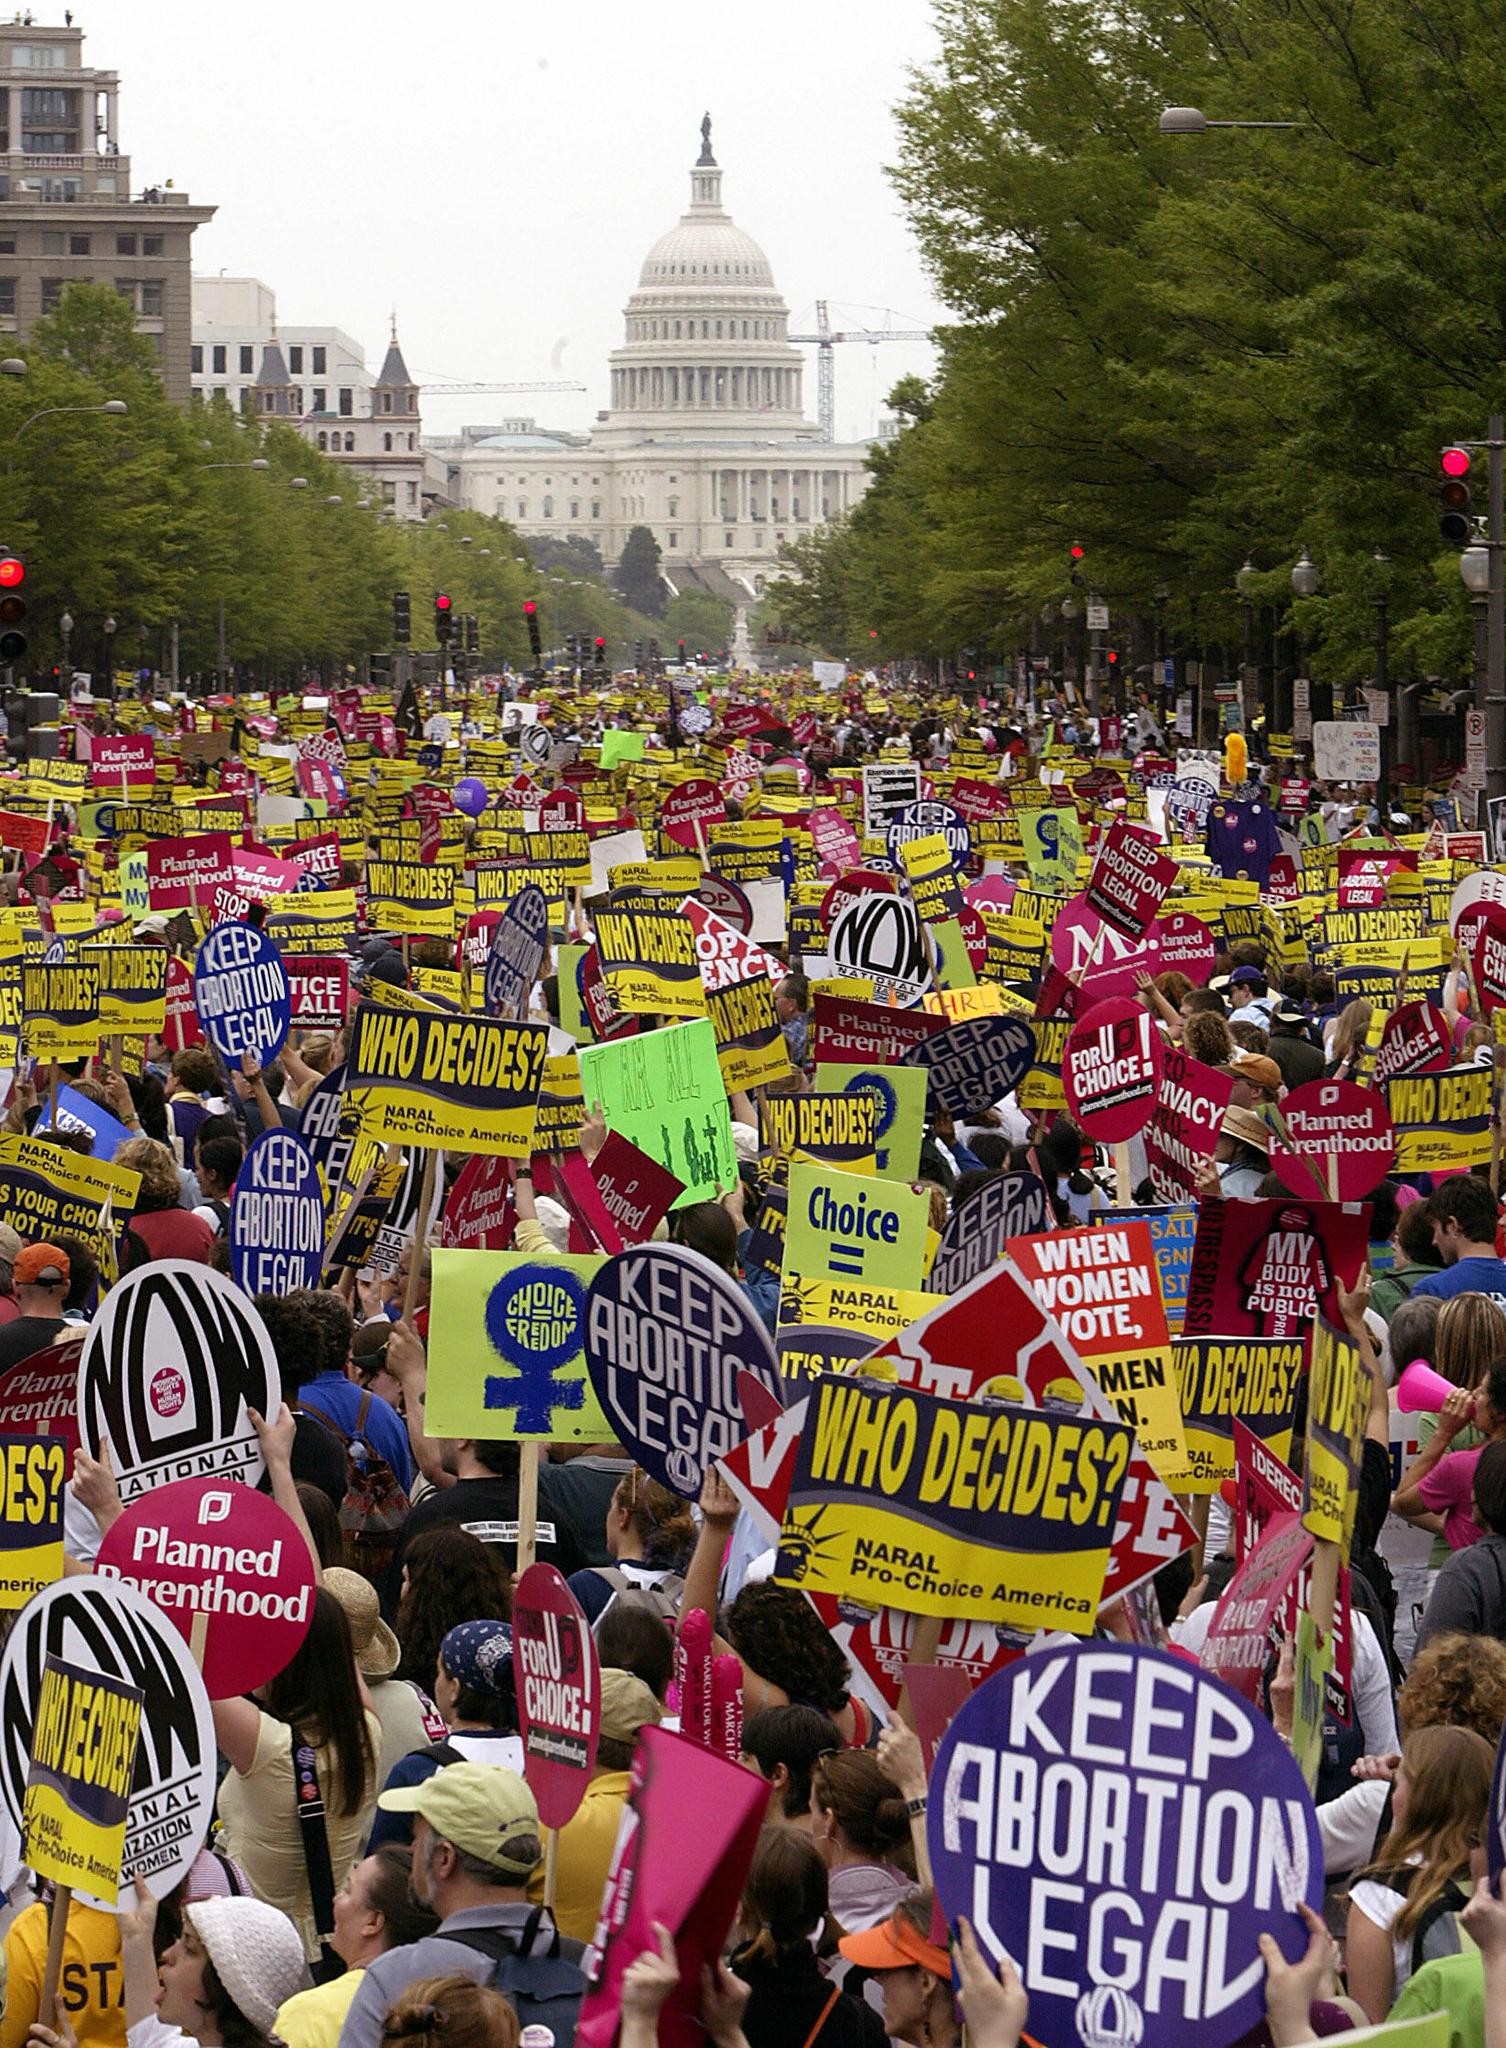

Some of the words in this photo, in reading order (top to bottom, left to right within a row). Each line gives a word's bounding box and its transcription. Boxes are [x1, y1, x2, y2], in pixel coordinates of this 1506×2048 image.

[93, 758, 154, 772] Parenthood
[101, 748, 144, 761] Planned
[28, 758, 48, 777] WHO
[48, 762, 88, 782] DECIDES?
[662, 803, 725, 826] Parenthood
[670, 794, 715, 809] Planned
[904, 802, 956, 826] KEEP
[114, 809, 138, 830] WHO
[141, 812, 183, 836] DECIDES?
[161, 852, 218, 870] Planned
[746, 852, 780, 864] CHOICE
[1120, 834, 1158, 867] KEEP
[150, 866, 233, 889] Parenthood
[369, 865, 399, 898] WHO
[396, 866, 454, 900] DECIDES?
[478, 871, 504, 899] WHO
[1102, 849, 1167, 901] ABORTION
[214, 887, 249, 917] STOP
[627, 898, 655, 910] YOUR
[1102, 876, 1139, 911] LEGAL
[1347, 890, 1373, 903] LEGAL
[269, 925, 286, 938] IT'S
[290, 924, 316, 937] YOUR
[318, 921, 355, 935] CHOICE
[419, 919, 452, 927] America
[986, 916, 1010, 926] NARAL
[1325, 914, 1356, 943] WHO
[1359, 910, 1422, 941] DECIDES?
[204, 926, 261, 973] KEEP
[312, 938, 348, 949] THEIRS.
[596, 914, 635, 961] WHO
[635, 914, 698, 967] DECIDES?
[696, 931, 737, 960] OP
[832, 899, 931, 982] NOW
[1159, 943, 1215, 961] renthood
[1161, 930, 1202, 946] lanned
[700, 953, 785, 991] ENCE
[1006, 951, 1042, 967] CHOICE
[25, 969, 48, 1010] WHO
[196, 960, 286, 1018] ABORTION
[288, 977, 341, 995] TICE
[432, 974, 454, 985] NARAL
[630, 984, 657, 992] NARAL
[1338, 980, 1360, 994] IT'S
[1361, 978, 1393, 992] YOUR
[298, 996, 341, 1013] ALL
[386, 988, 414, 1009] NARAL
[632, 994, 673, 1004] Pro-Choice
[675, 998, 704, 1007] America
[210, 1007, 283, 1057] LEGAL
[818, 1026, 911, 1057] Parenth
[838, 1012, 929, 1041] Planned
[357, 1012, 420, 1080] WHO
[422, 1024, 546, 1092] DECIDES?
[905, 1020, 993, 1067] KEEP
[930, 1026, 1028, 1089] ORTION
[759, 1058, 788, 1073] America
[1070, 1048, 1101, 1074] FOR
[936, 1061, 1024, 1111] EGAL
[1389, 1077, 1436, 1124] WHO
[384, 1104, 436, 1122] NARAL
[800, 1096, 875, 1146] DECIDES?
[1286, 1108, 1373, 1132] Planned
[383, 1118, 465, 1140] Pro-Choice
[468, 1128, 528, 1146] America
[20, 1142, 66, 1167] NARAL
[252, 1134, 311, 1190] KEEP
[17, 1154, 81, 1181] Pro-Choice
[84, 1178, 133, 1198] America
[15, 1190, 59, 1219] YOUR
[469, 1184, 502, 1211] Planned
[596, 1177, 652, 1231] Planned
[3, 1211, 37, 1235] NOT
[234, 1197, 321, 1253] ABORTION
[350, 1215, 378, 1239] IT'S
[458, 1205, 505, 1239] Parenthood
[808, 1186, 899, 1245] Choice
[1032, 1230, 1131, 1273] WHEN
[1266, 1232, 1315, 1265] MY
[1029, 1264, 1152, 1310] WOMEN
[1262, 1264, 1311, 1285] BODY
[506, 1282, 577, 1319] CHOICE
[618, 1258, 744, 1347] KEEP
[830, 1288, 899, 1312] NARAL
[1253, 1280, 1275, 1295] is
[1278, 1285, 1317, 1301] not
[828, 1306, 917, 1328] Pro-Choic
[1247, 1296, 1320, 1319] PUBLIC
[506, 1316, 577, 1352] FREEDOM
[84, 1271, 269, 1472] NOW
[781, 1350, 824, 1383] IT'S
[1201, 1344, 1302, 1416] DECIDES?
[4, 1372, 78, 1397] Plann
[810, 1383, 919, 1497] WHO
[917, 1408, 1130, 1529] DECIDES?
[132, 1525, 282, 1580] Planned
[855, 1537, 940, 1575] NARAL
[849, 1558, 984, 1599] Pro-Choice
[991, 1582, 1092, 1615] America
[519, 1638, 549, 1673] FOR
[704, 1655, 712, 1698] MARCH
[725, 1702, 735, 1750] MARCH
[1010, 1652, 1255, 1782] KEEP
[34, 1669, 69, 1772] WHO
[63, 1679, 141, 1799] DECIDES?
[39, 1811, 63, 1841] NARAL
[944, 1742, 1310, 1914] ABORTION
[37, 1832, 88, 1870] Pro-Choice
[87, 1851, 118, 1886] America
[120, 1848, 180, 1882] WOMEN
[973, 1864, 1267, 2022] LEGAL
